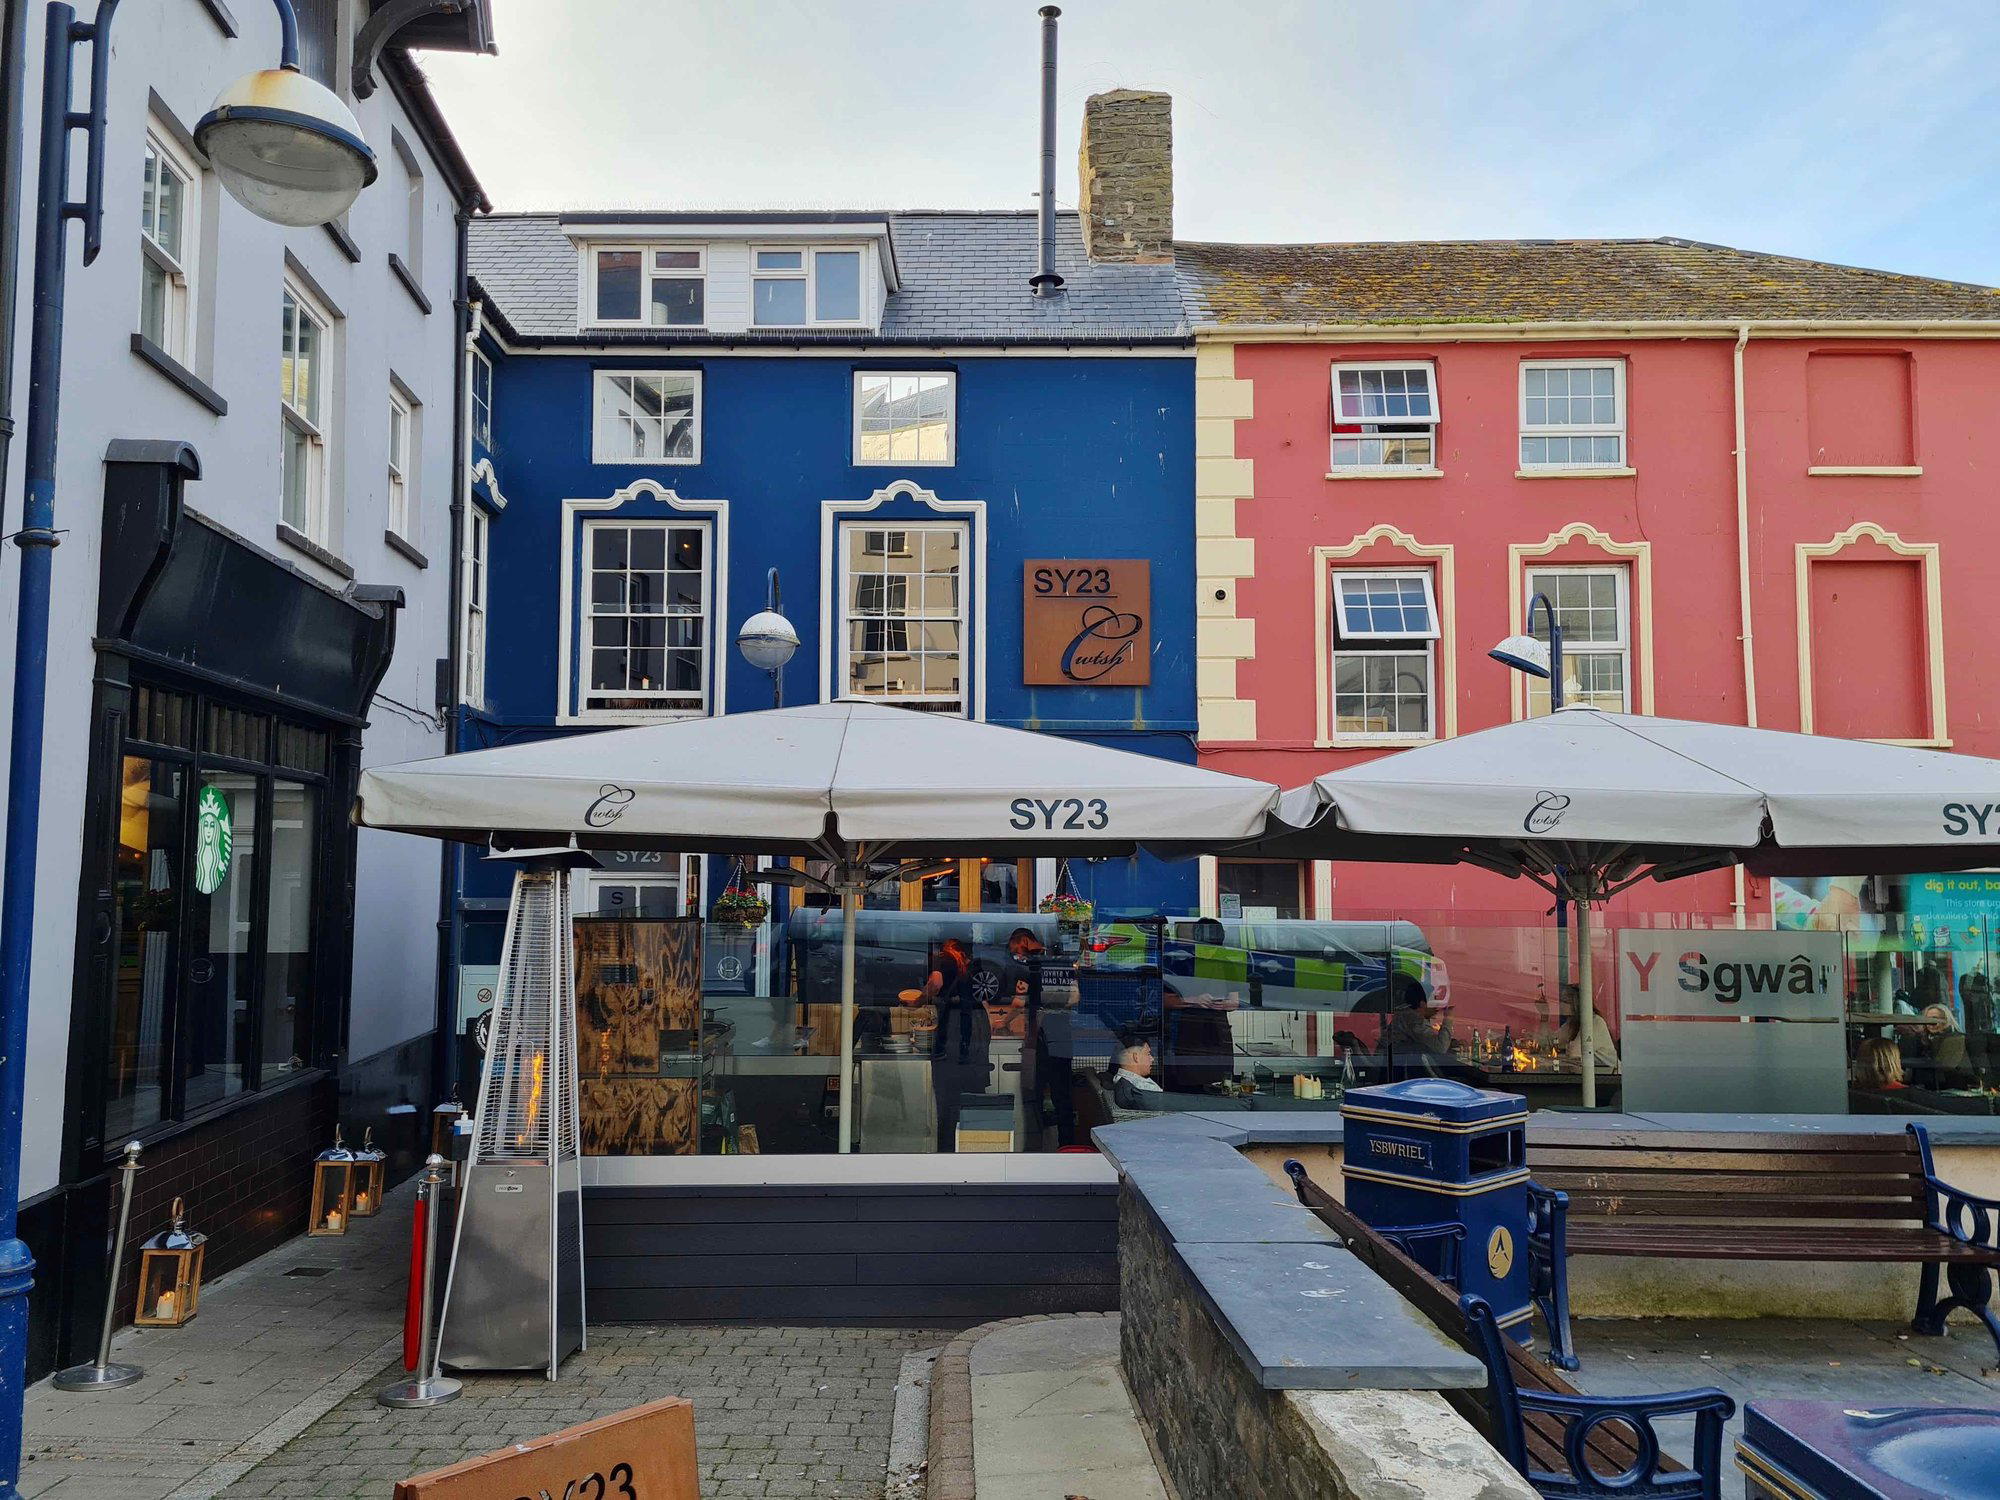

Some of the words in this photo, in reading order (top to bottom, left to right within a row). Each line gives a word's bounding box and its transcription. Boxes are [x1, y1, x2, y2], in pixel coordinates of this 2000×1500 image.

[1034, 568, 1111, 594] SY23
[1061, 605, 1143, 681] Cwtsh
[584, 784, 636, 828] Cwtsh
[1009, 798, 1109, 830] SY23
[1523, 790, 1571, 834] Cwtsh
[616, 852, 662, 863] SY23
[611, 891, 624, 905] S
[1925, 878, 1944, 893] dig
[1947, 879, 1955, 890] it
[1958, 880, 1982, 892] out,
[1945, 898, 1963, 907] This
[1626, 951, 1662, 992] Y
[1677, 951, 1837, 1003] Sgwâr
[1369, 1139, 1426, 1160] YSBWRIEL
